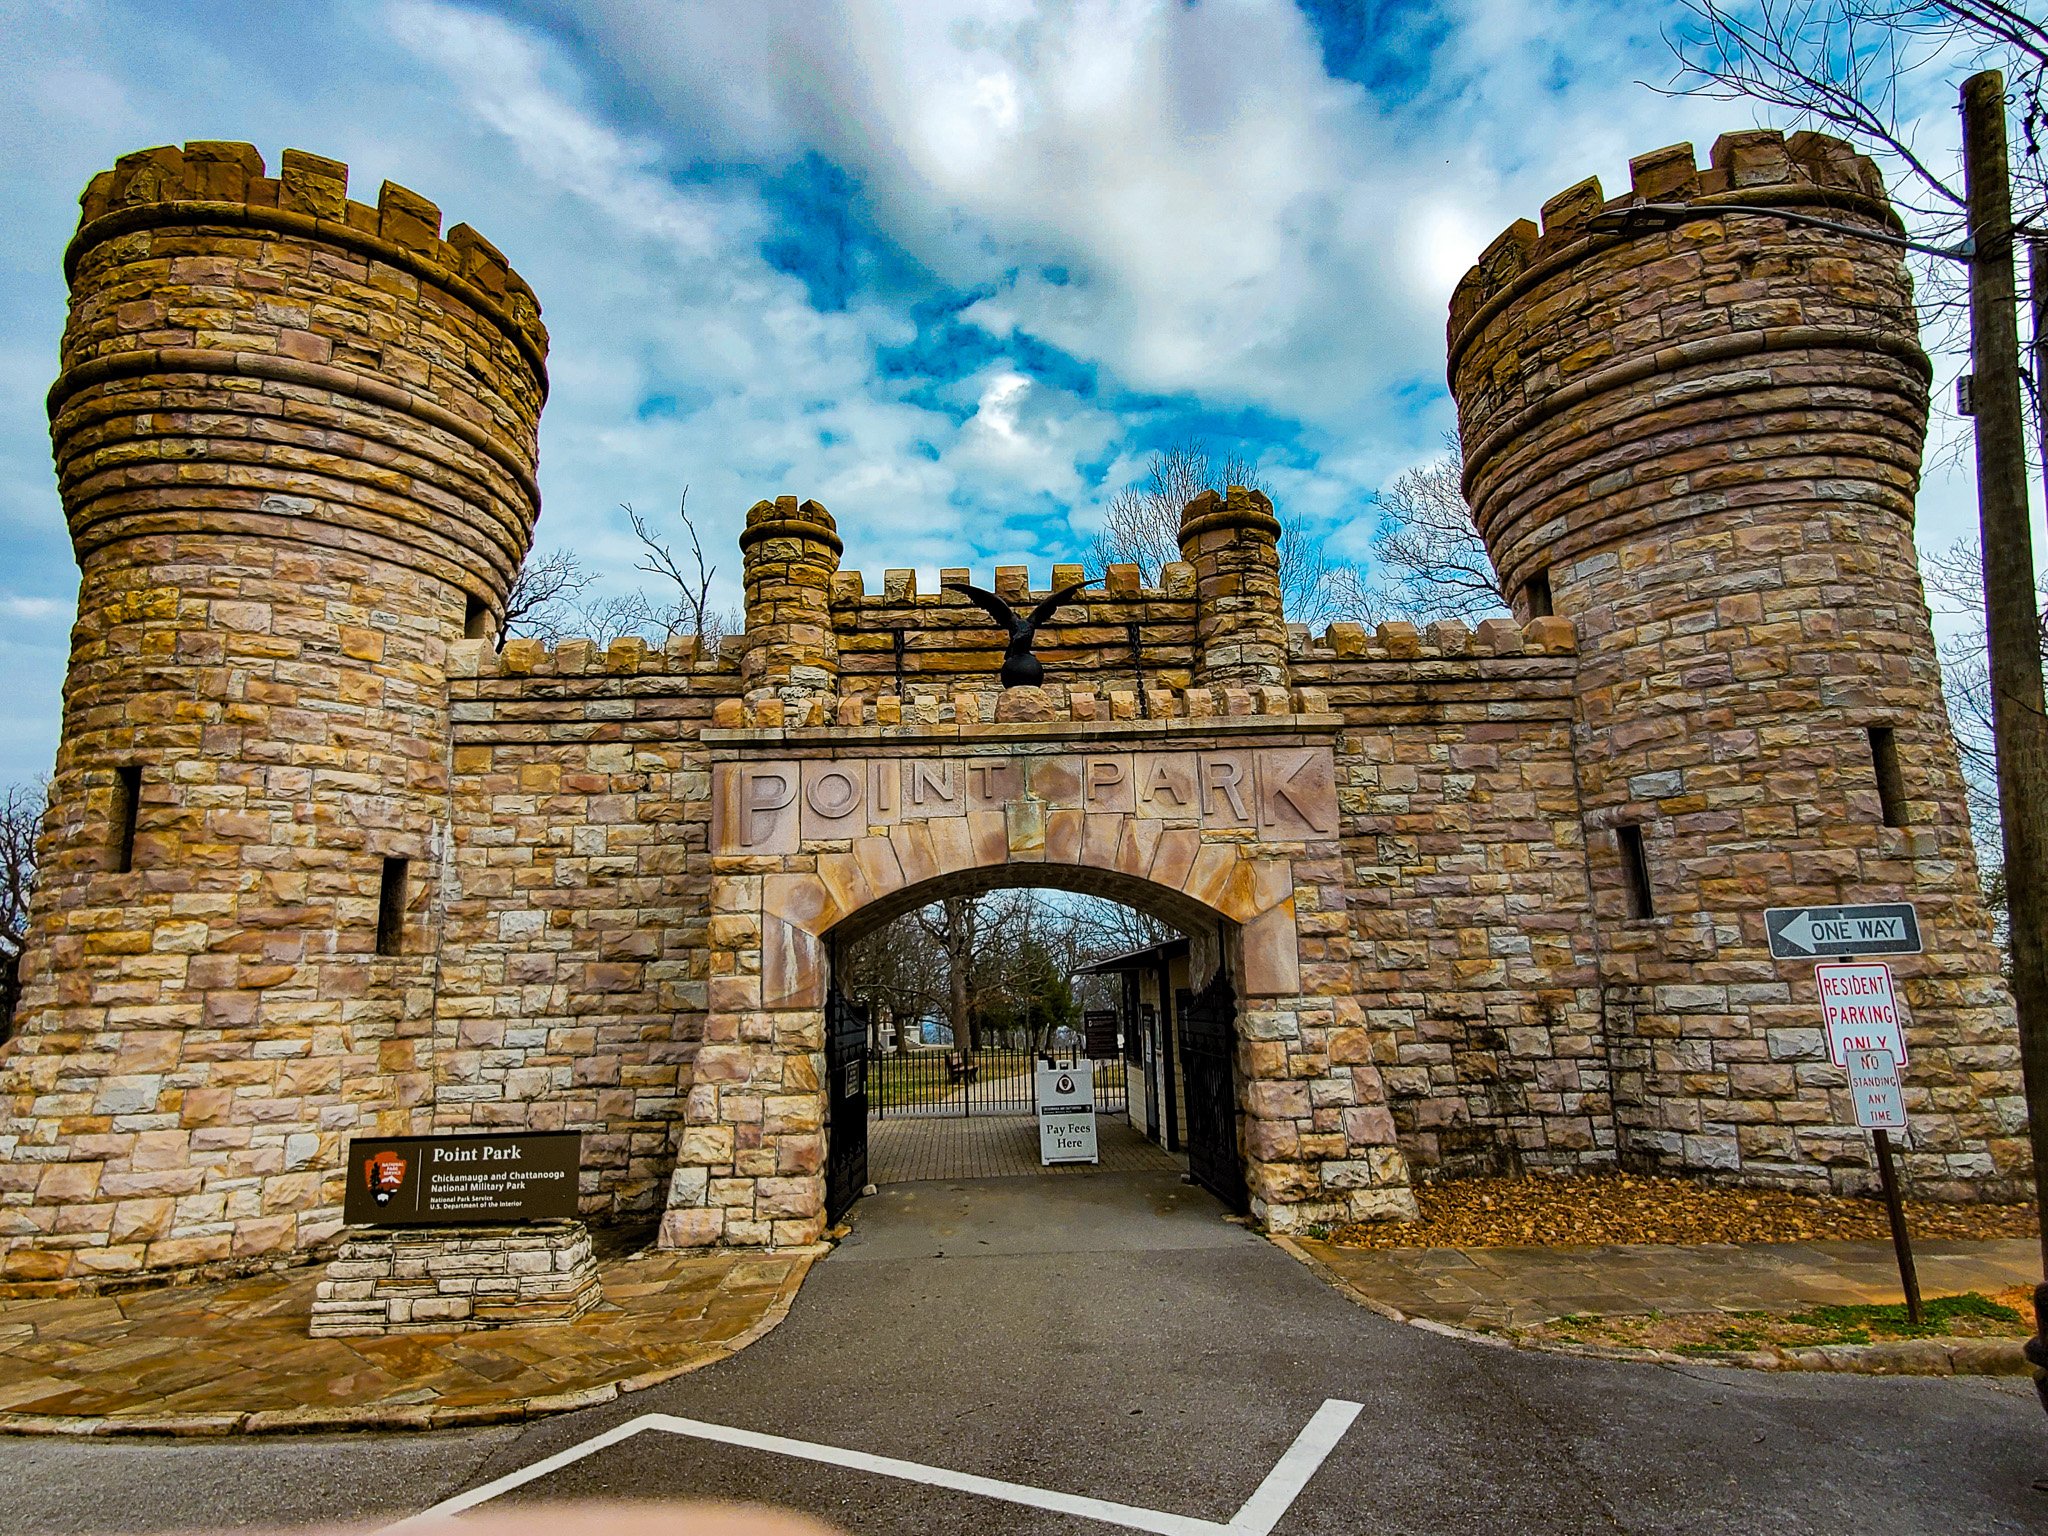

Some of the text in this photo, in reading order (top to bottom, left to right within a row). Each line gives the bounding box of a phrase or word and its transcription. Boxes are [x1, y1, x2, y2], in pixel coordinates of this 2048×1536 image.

[740, 752, 1329, 847] POINT PARK
[1811, 919, 1897, 941] ONE WAY
[1823, 976, 1885, 996] RESIDENT
[1830, 1005, 1893, 1025] PARKING
[1861, 1054, 1879, 1070] NO
[1853, 1077, 1897, 1088] STANDING
[1868, 1094, 1887, 1104] ANY
[1870, 1111, 1892, 1121] TIME
[1046, 1123, 1091, 1136] Pay Fees
[1057, 1138, 1083, 1148] Here
[433, 1144, 522, 1162] Point Park
[431, 1170, 565, 1183] Chickamauga and Chattanooga
[431, 1181, 526, 1193] National Military Park
[443, 1202, 479, 1210] Department
